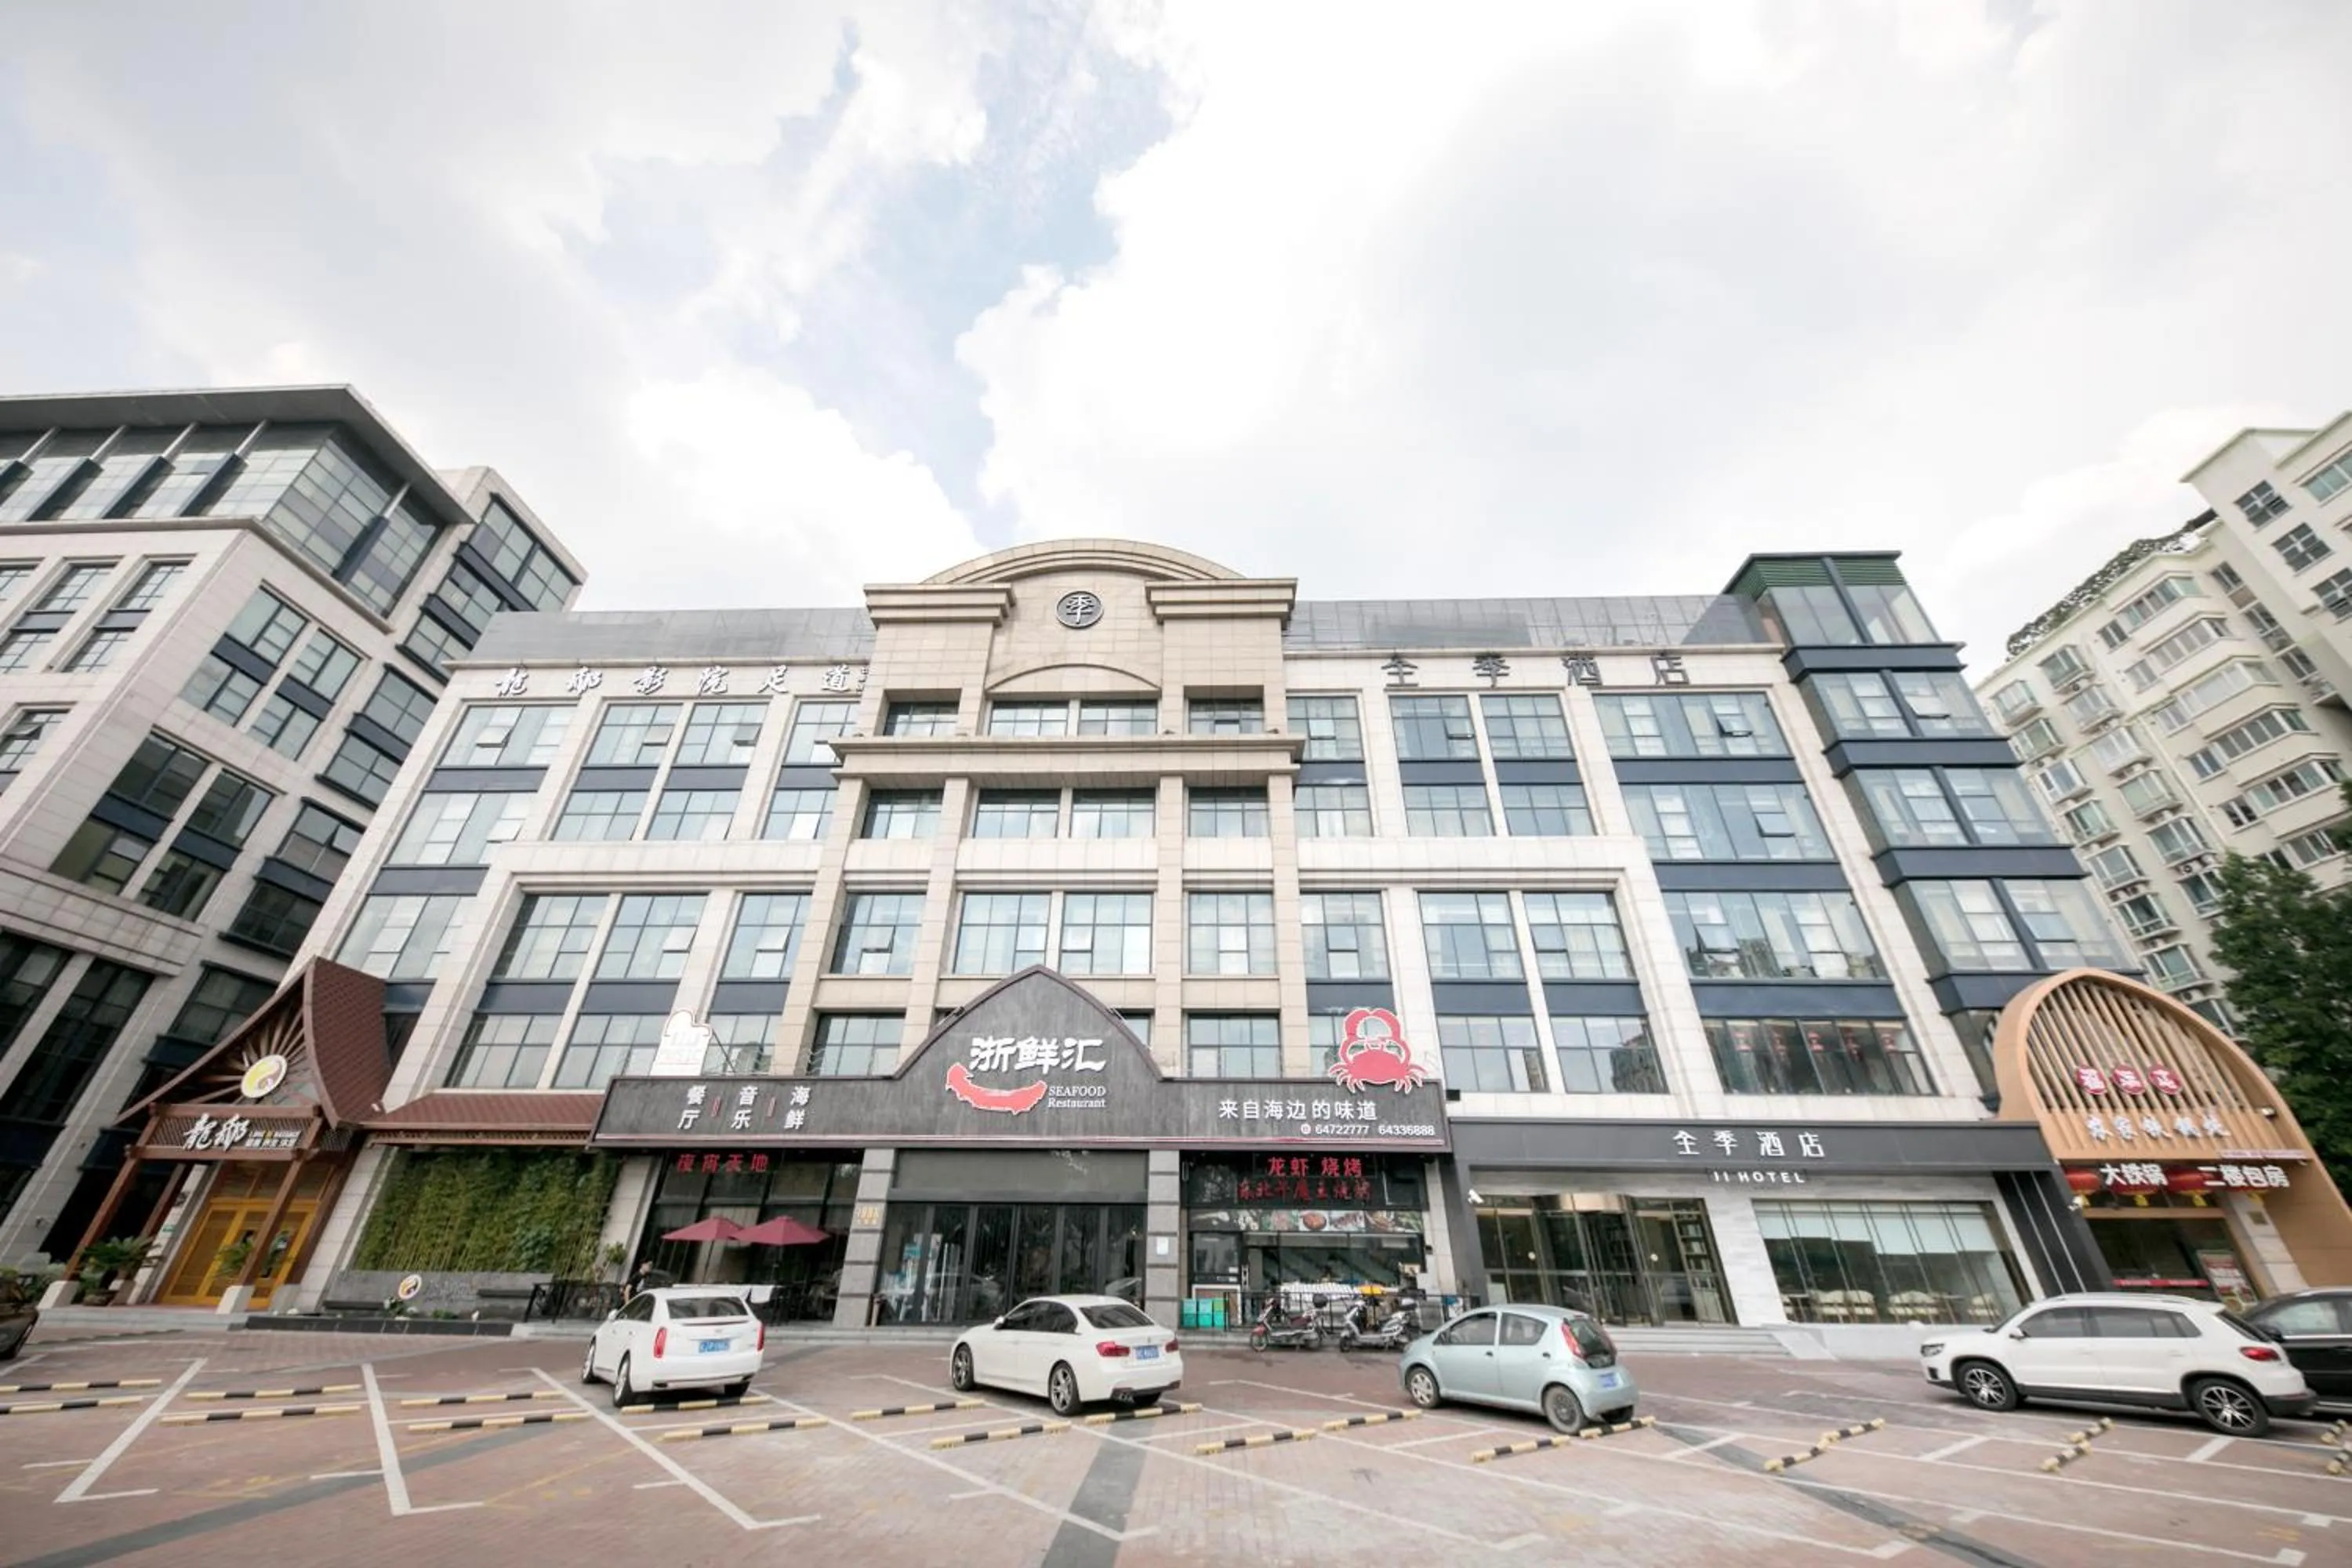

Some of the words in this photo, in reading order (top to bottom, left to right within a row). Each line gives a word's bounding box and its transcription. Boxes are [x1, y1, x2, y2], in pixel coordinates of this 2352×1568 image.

[1066, 597, 1094, 624] 季
[1381, 652, 1690, 688] 全季酒店
[969, 1036, 1106, 1074] 浙鲜汇
[1048, 1085, 1106, 1097] SEAFOOD
[1048, 1098, 1106, 1108] Restaurant
[731, 1085, 758, 1129] 音乐
[784, 1085, 811, 1129] 海鲜
[1219, 1099, 1377, 1120] 来自海边的味道
[1315, 1124, 1370, 1135] 64722777
[1672, 1129, 1825, 1157] 全季酒店
[1269, 1157, 1309, 1176] 龙虾
[1322, 1157, 1362, 1177] 烧烤
[1737, 1171, 1806, 1184] HOTEL
